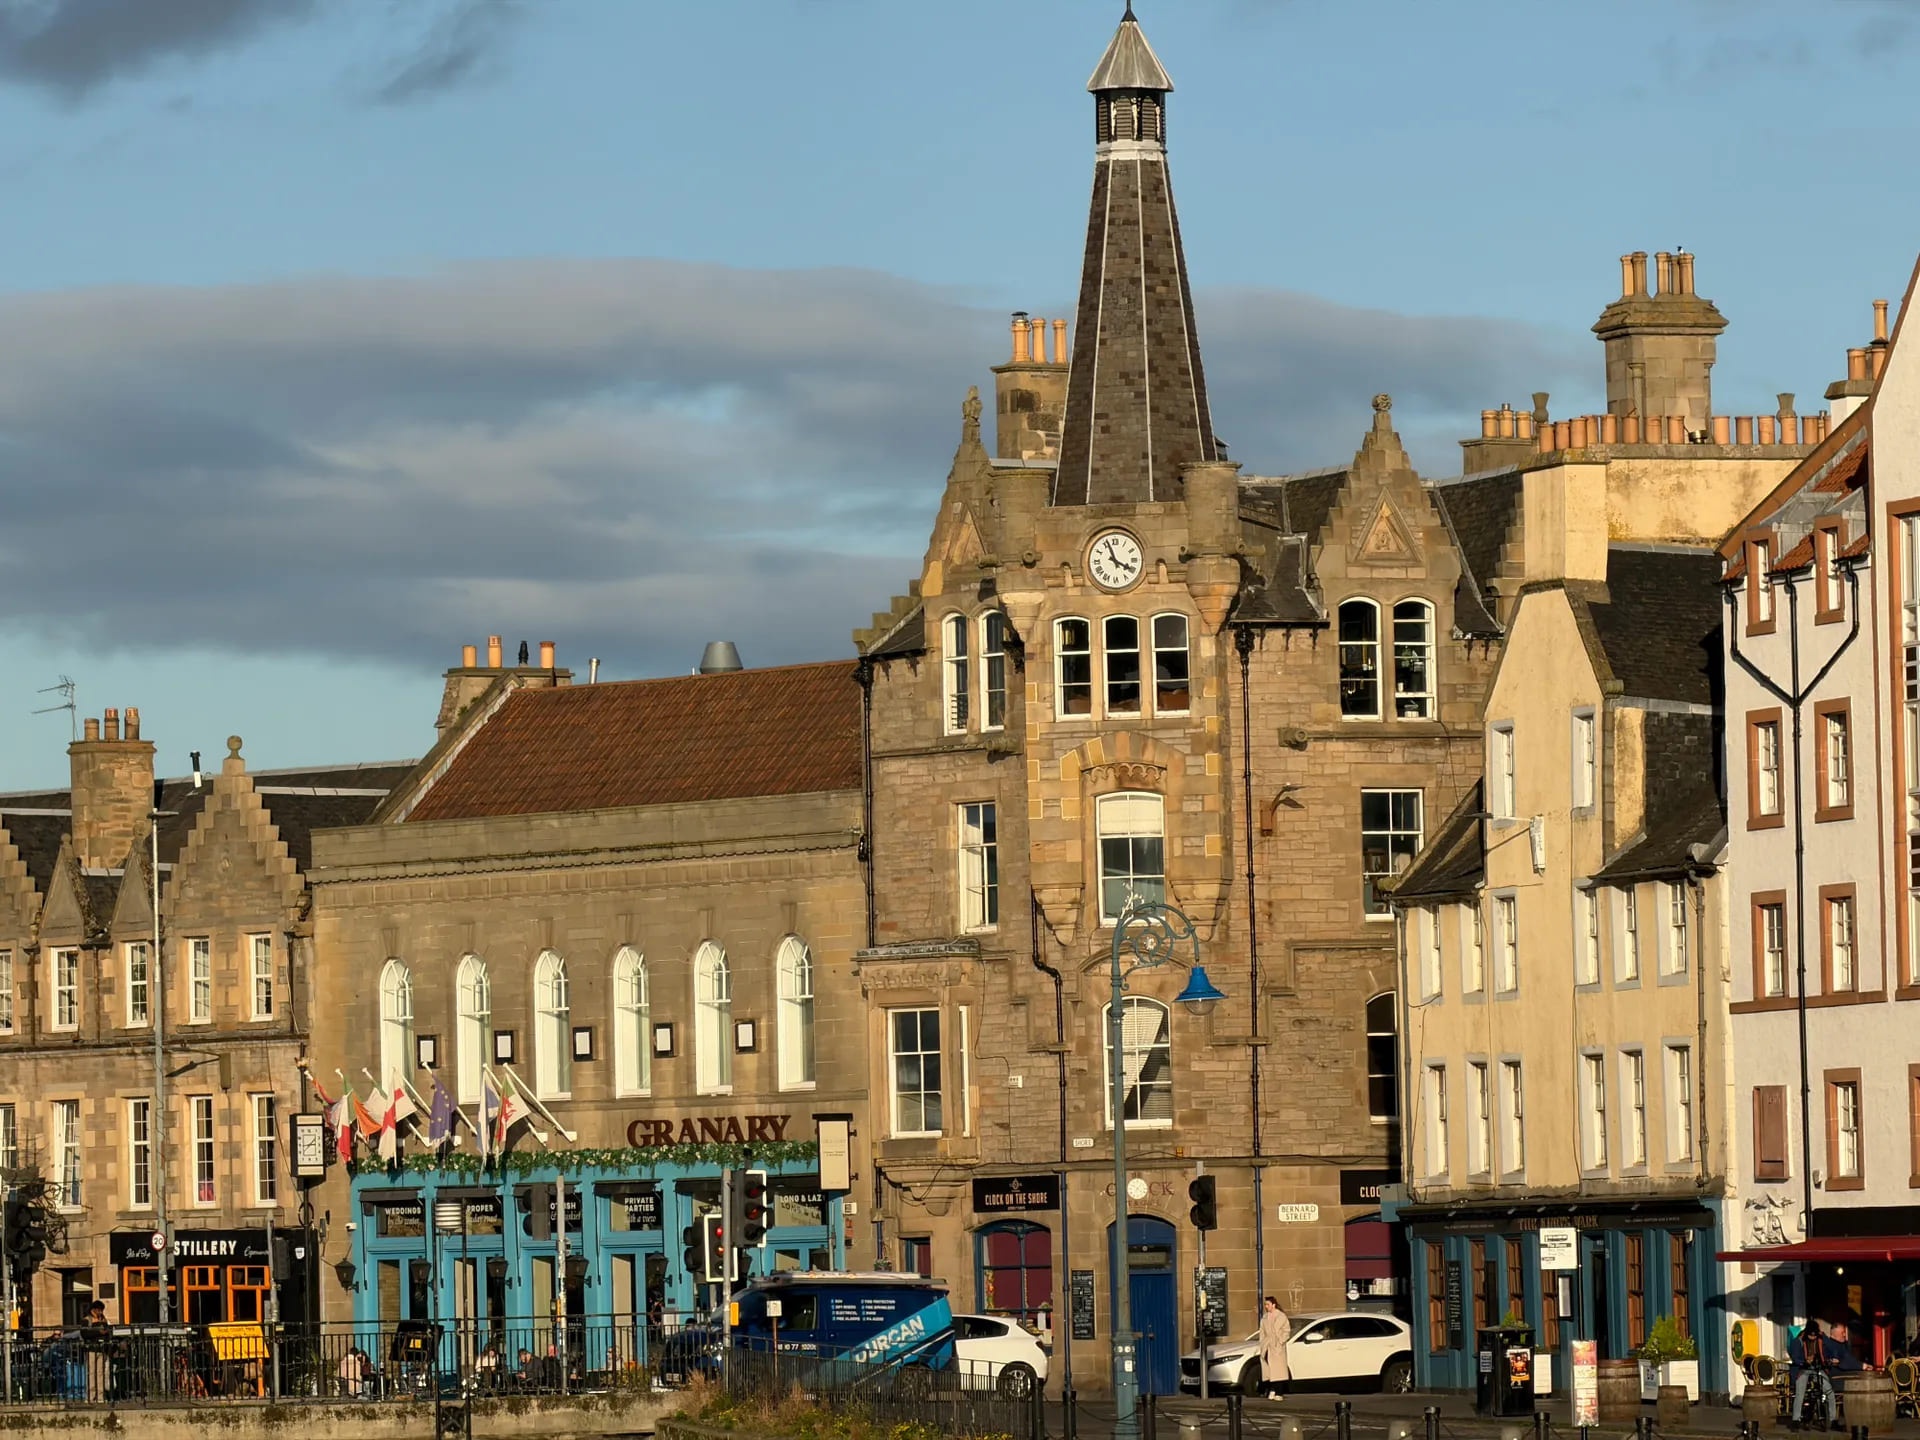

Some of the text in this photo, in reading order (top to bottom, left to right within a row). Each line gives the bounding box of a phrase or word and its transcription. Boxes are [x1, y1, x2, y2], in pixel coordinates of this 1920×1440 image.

[626, 1115, 791, 1148] GRANARY
[1360, 1186, 1380, 1198] CLOC
[985, 1192, 1048, 1206] CLOCK ON THE SHORE
[385, 1207, 422, 1215] WEDDINGS
[466, 1204, 493, 1213] PROPER
[624, 1204, 655, 1212] PARTIES
[1281, 1205, 1316, 1213] BERNARD
[153, 1237, 163, 1245] 20
